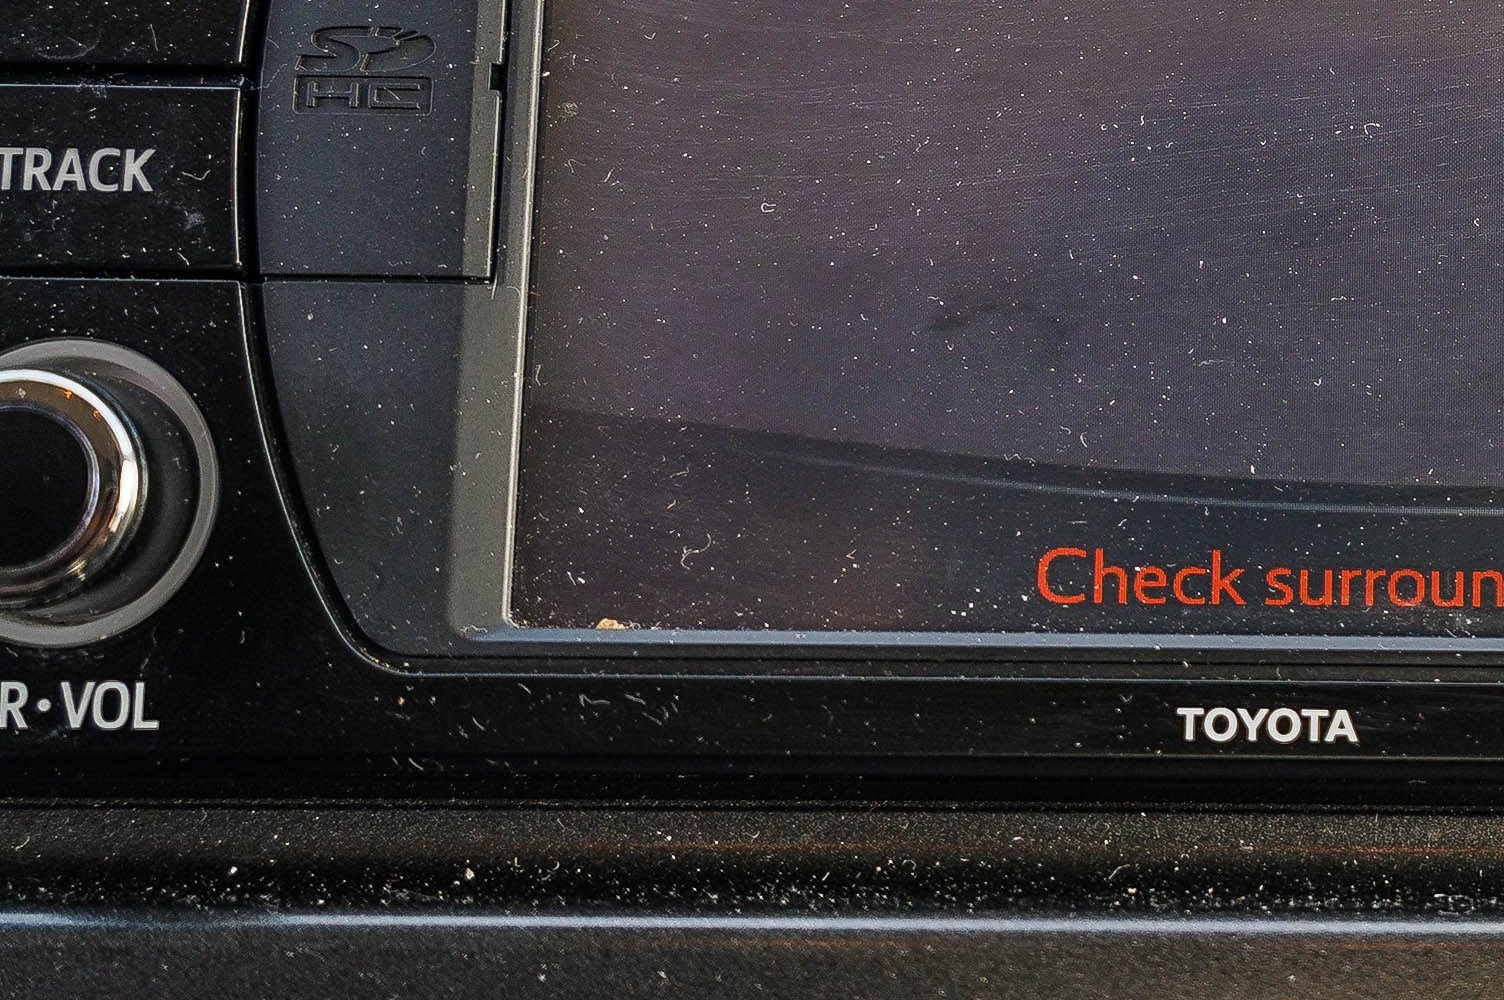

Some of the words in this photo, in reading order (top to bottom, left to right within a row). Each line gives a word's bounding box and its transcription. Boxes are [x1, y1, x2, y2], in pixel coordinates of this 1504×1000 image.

[0, 147, 156, 192] TRACK
[1037, 547, 1243, 606] Check
[1176, 706, 1359, 744] TOYOTA
